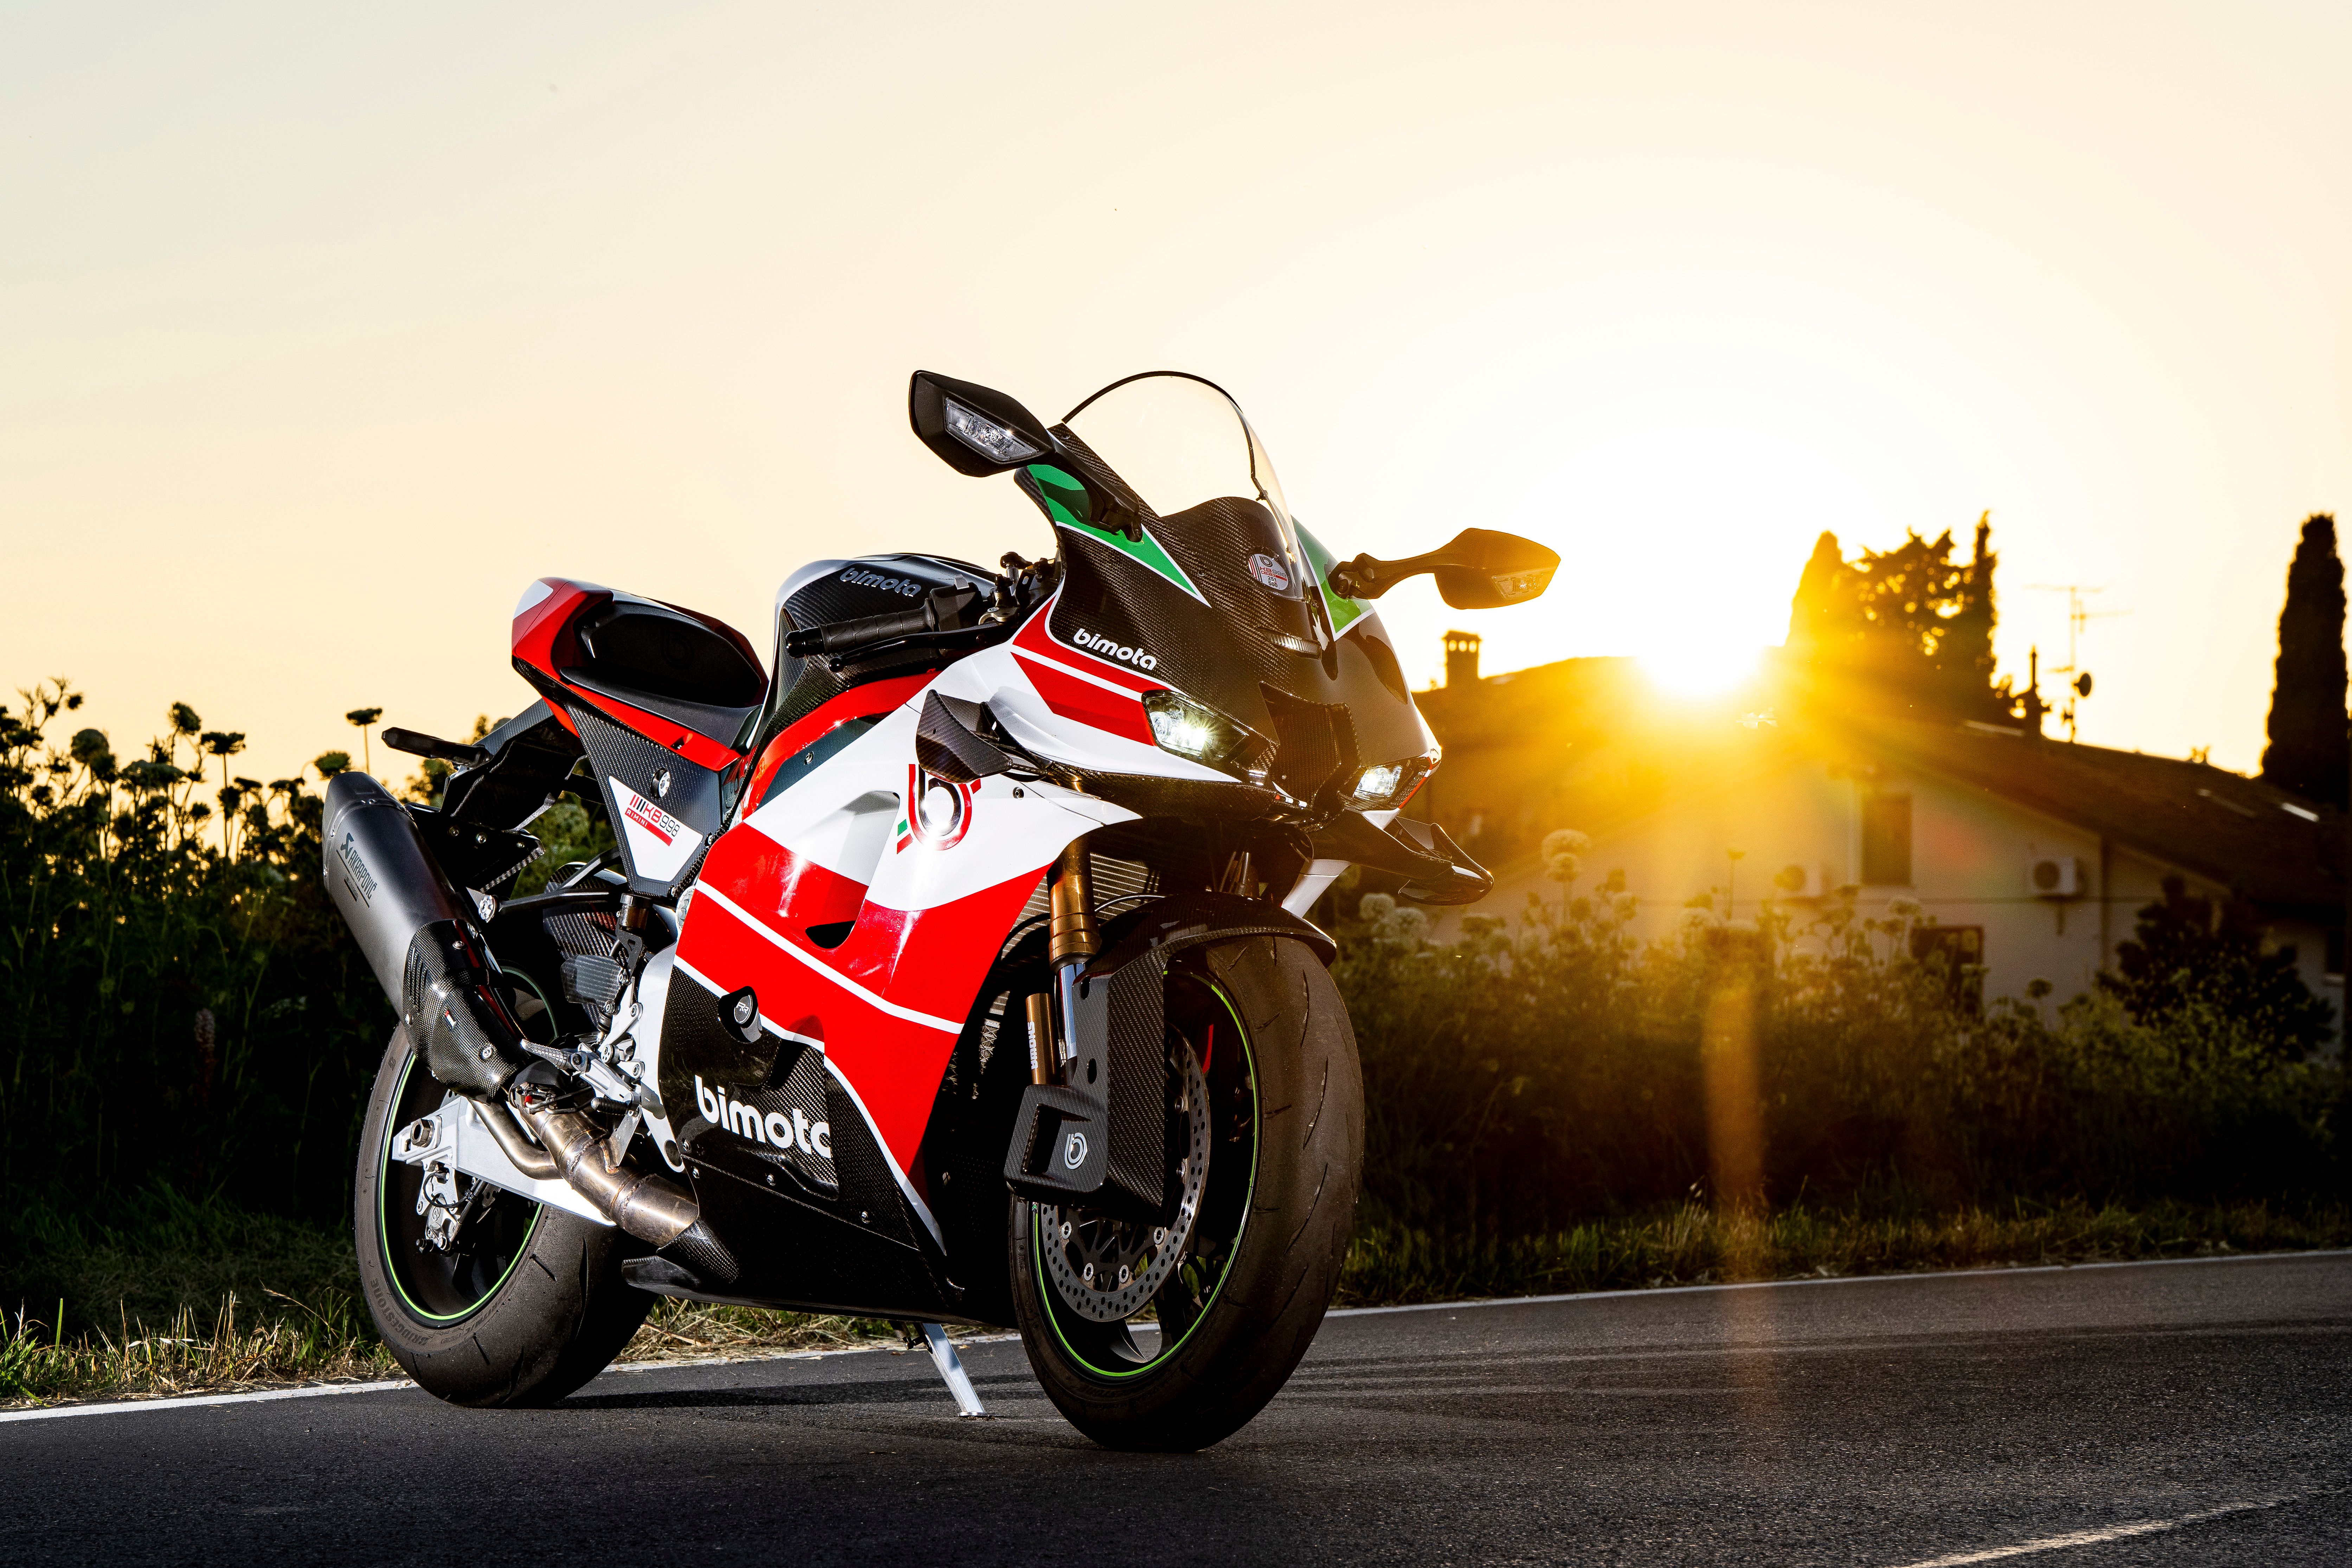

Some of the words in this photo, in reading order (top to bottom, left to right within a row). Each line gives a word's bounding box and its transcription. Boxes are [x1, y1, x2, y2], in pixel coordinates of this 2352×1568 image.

[840, 568, 921, 597] bimota
[1260, 566, 1287, 578] KB998
[1073, 628, 1157, 671] bimota
[626, 809, 648, 827] RIMINI
[643, 803, 680, 837] KB998
[1027, 1021, 1038, 1070] SHOWA
[370, 1278, 429, 1346] BRIDGESTONE
